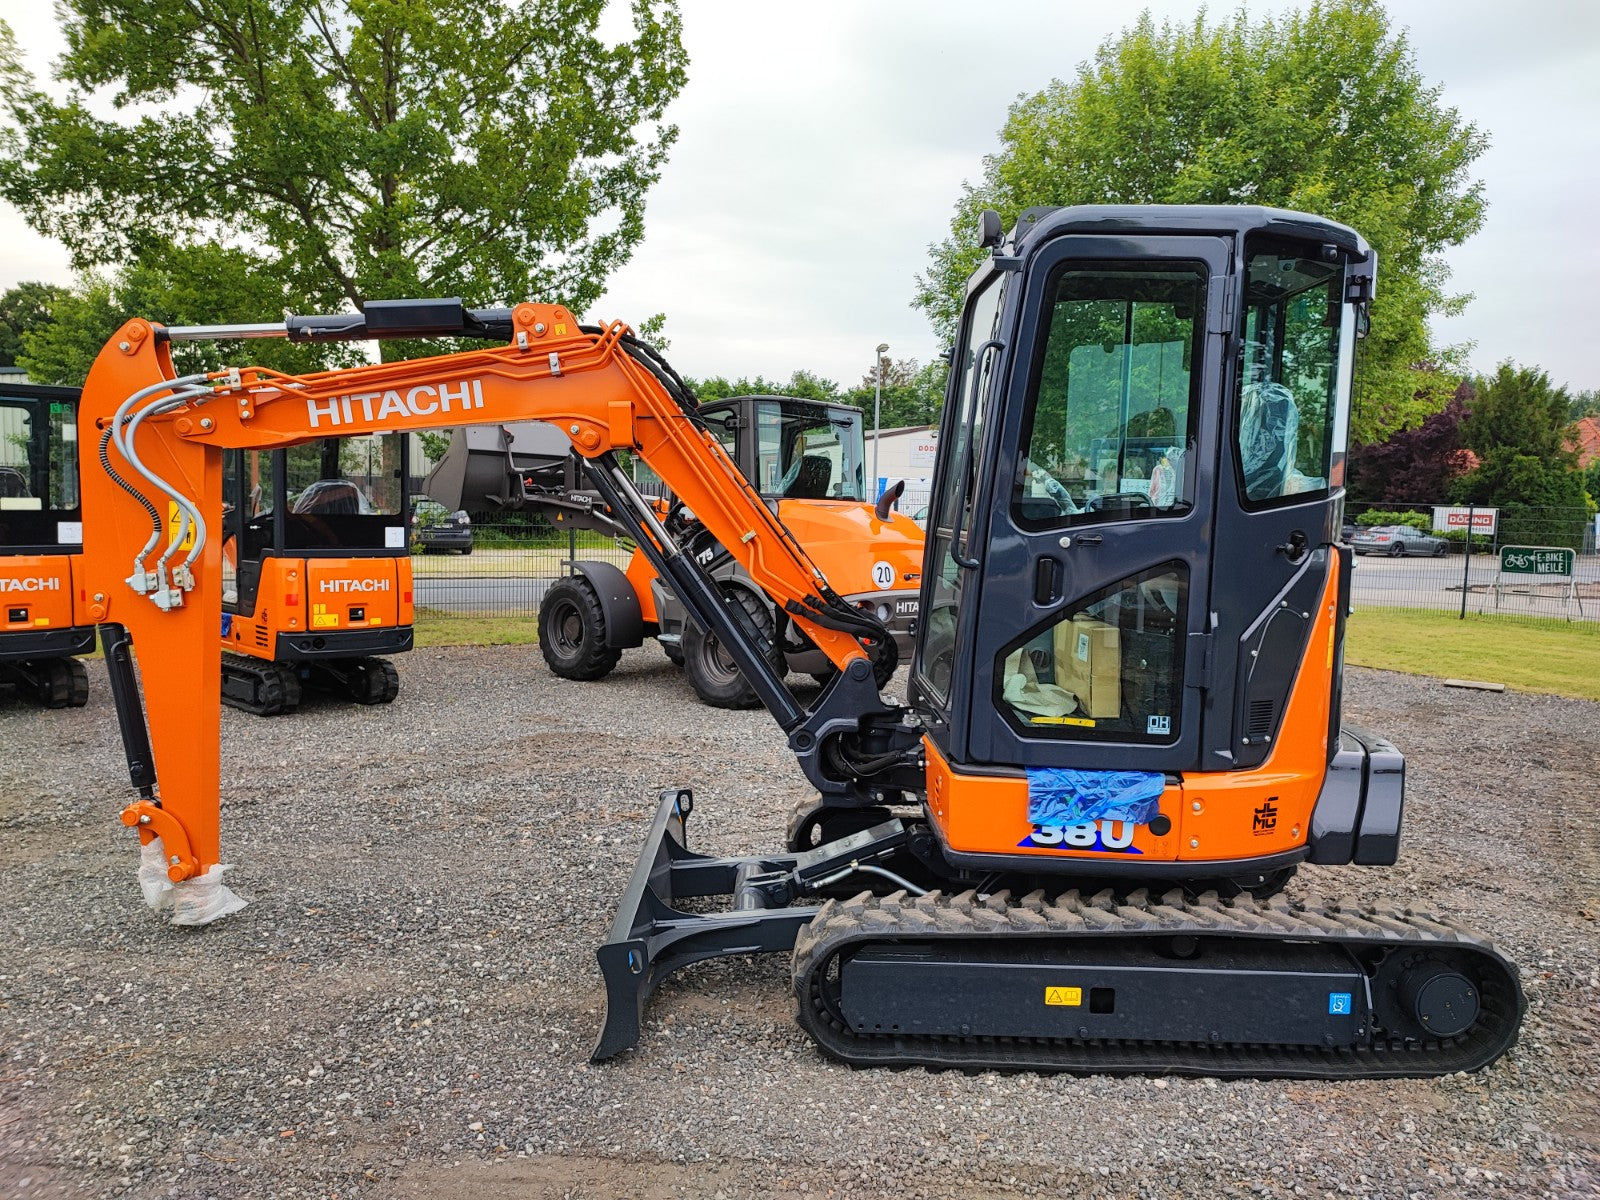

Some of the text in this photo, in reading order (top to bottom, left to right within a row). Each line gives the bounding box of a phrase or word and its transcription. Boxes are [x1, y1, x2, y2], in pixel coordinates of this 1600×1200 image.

[307, 379, 485, 428] HITACHI
[570, 494, 592, 503] HITACHI
[695, 547, 714, 565] 75
[1537, 552, 1564, 562] E-BIKE
[877, 566, 891, 583] 20
[1537, 562, 1564, 573] MEILE
[0, 577, 60, 592] TACHI
[320, 579, 389, 593] HITACHI
[1030, 820, 1135, 851] 38U
